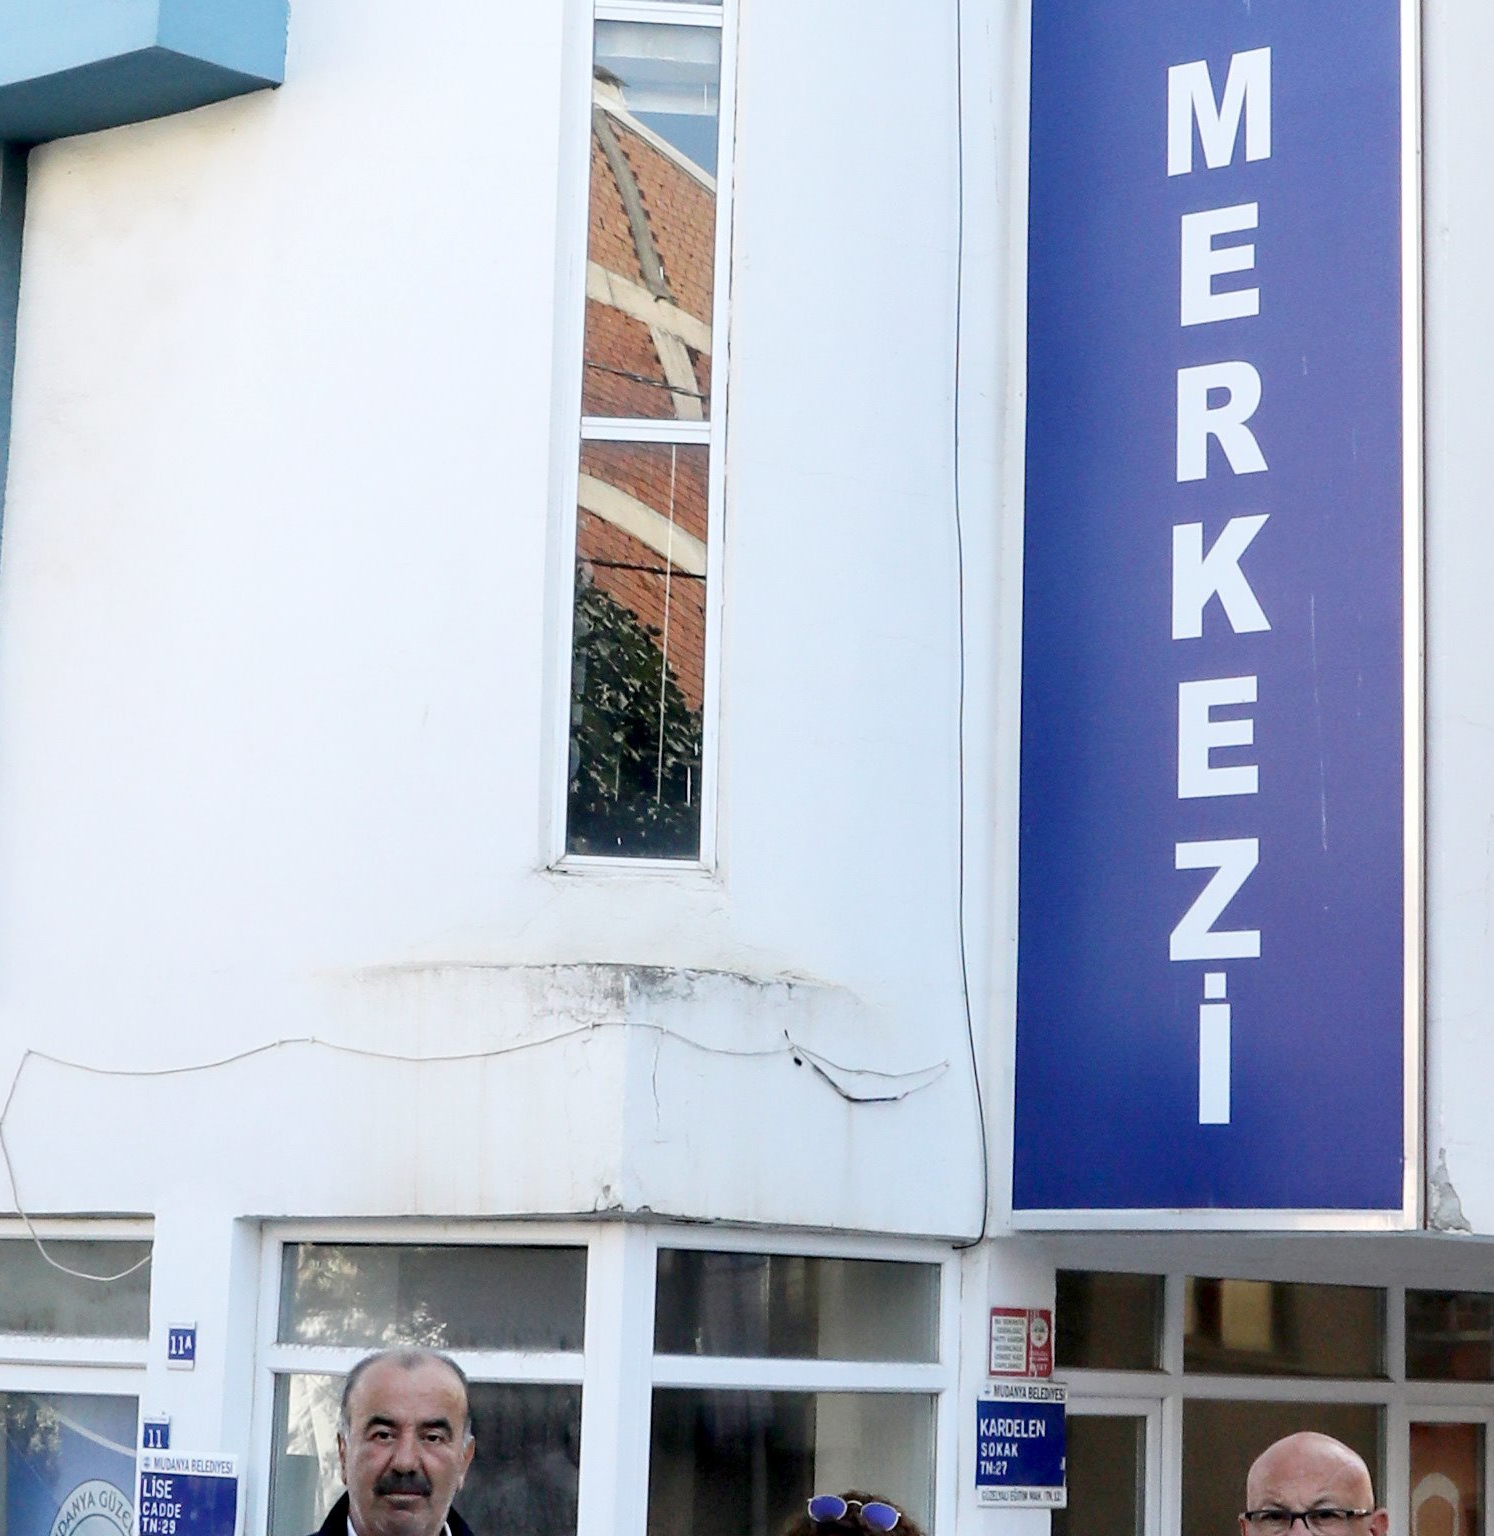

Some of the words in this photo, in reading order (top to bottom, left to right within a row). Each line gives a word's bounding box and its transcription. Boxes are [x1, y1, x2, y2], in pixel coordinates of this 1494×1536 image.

[1165, 45, 1273, 1126] MERKEZİ
[170, 1335, 193, 1355] 11A
[993, 1384, 1026, 1399] MUDANYA
[979, 1418, 1046, 1438] KARDELEN
[148, 1429, 162, 1448] 11
[980, 1442, 1019, 1457] SOKAK
[154, 1456, 190, 1473] MUDANYA
[979, 1460, 1008, 1476] TN:27
[142, 1474, 173, 1500] LİSE
[142, 1501, 182, 1519] CADDE
[142, 1517, 177, 1535] TN:29
